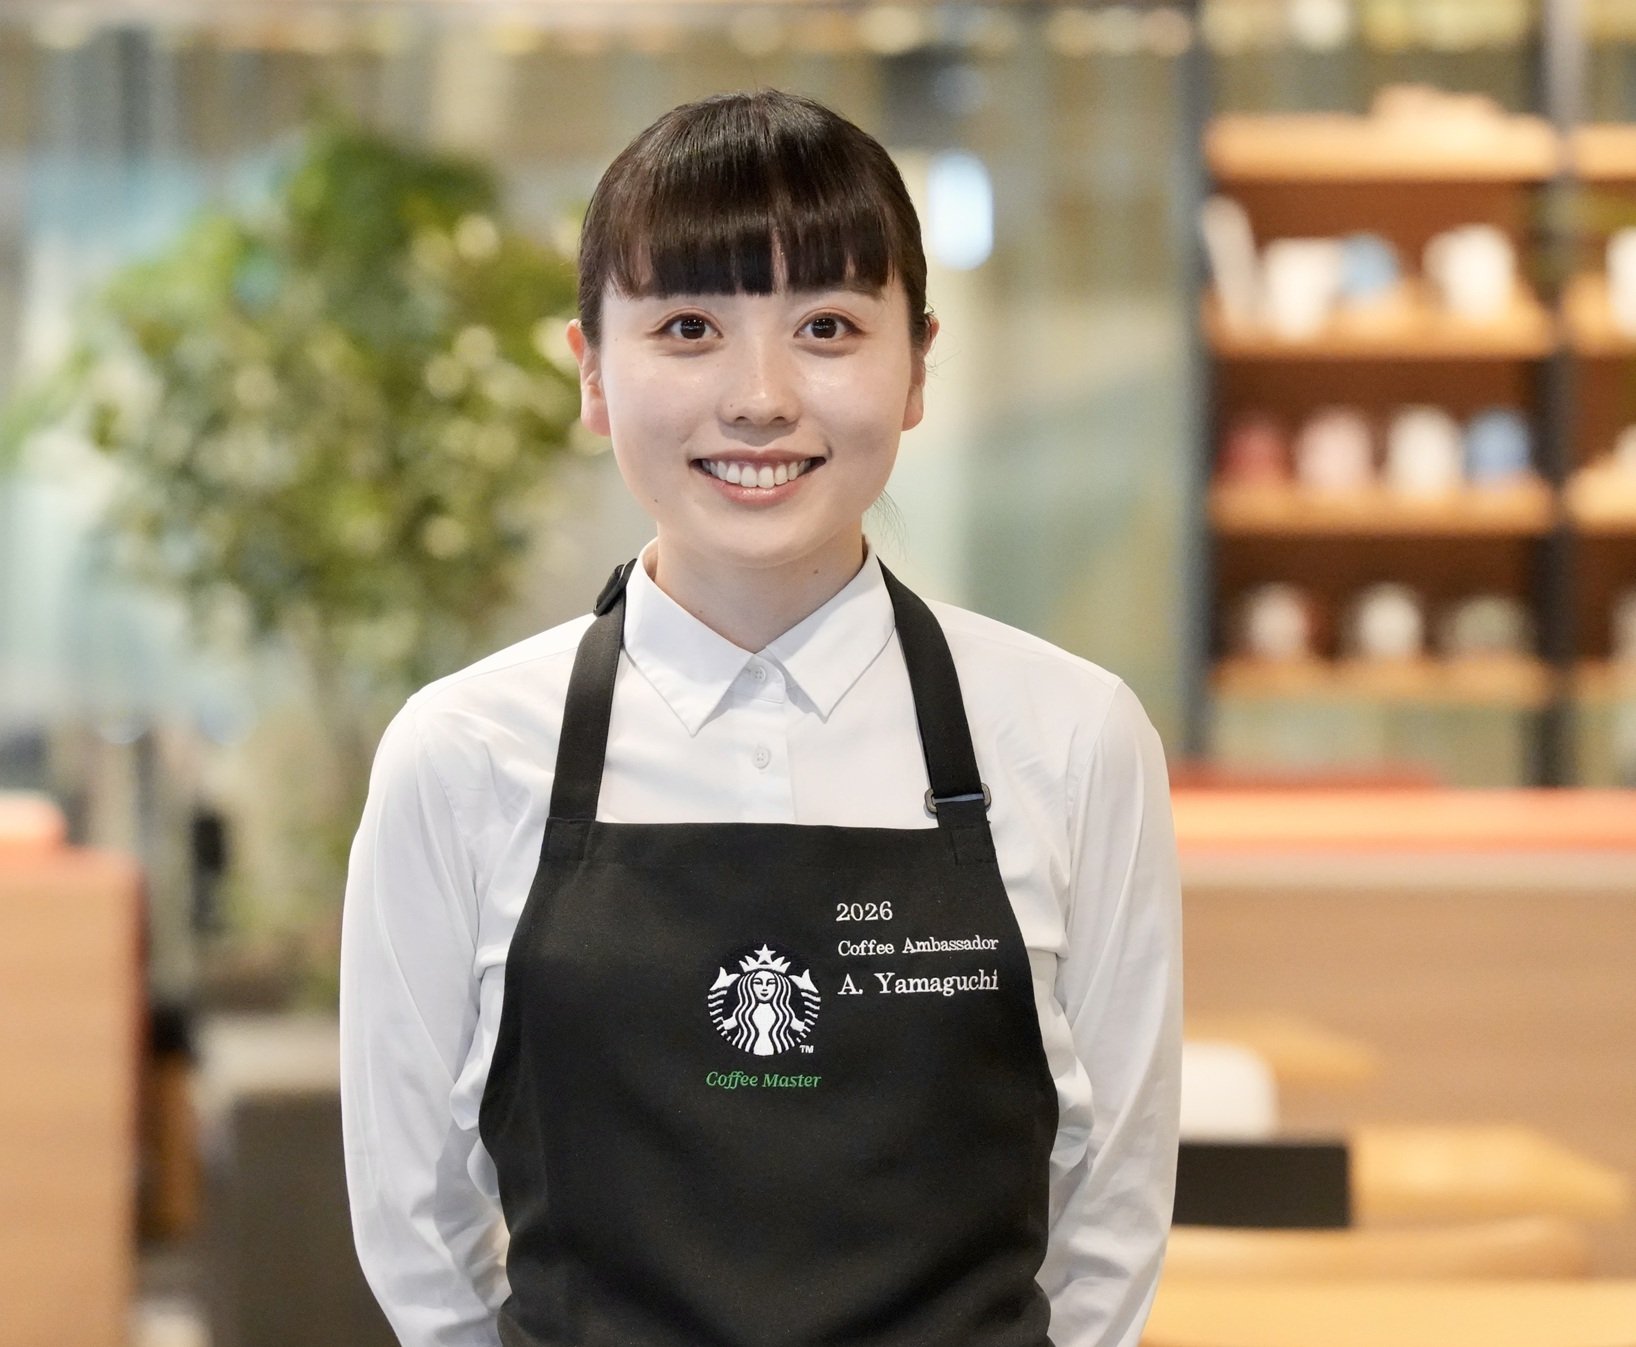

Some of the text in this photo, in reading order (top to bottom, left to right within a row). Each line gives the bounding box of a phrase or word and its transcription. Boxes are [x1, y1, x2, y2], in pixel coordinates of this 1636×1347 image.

[835, 900, 894, 922] 2026
[837, 934, 1000, 957] Coffee Ambassador
[837, 968, 999, 997] A. Yamaguchi
[705, 1070, 822, 1089] Coffee Master
